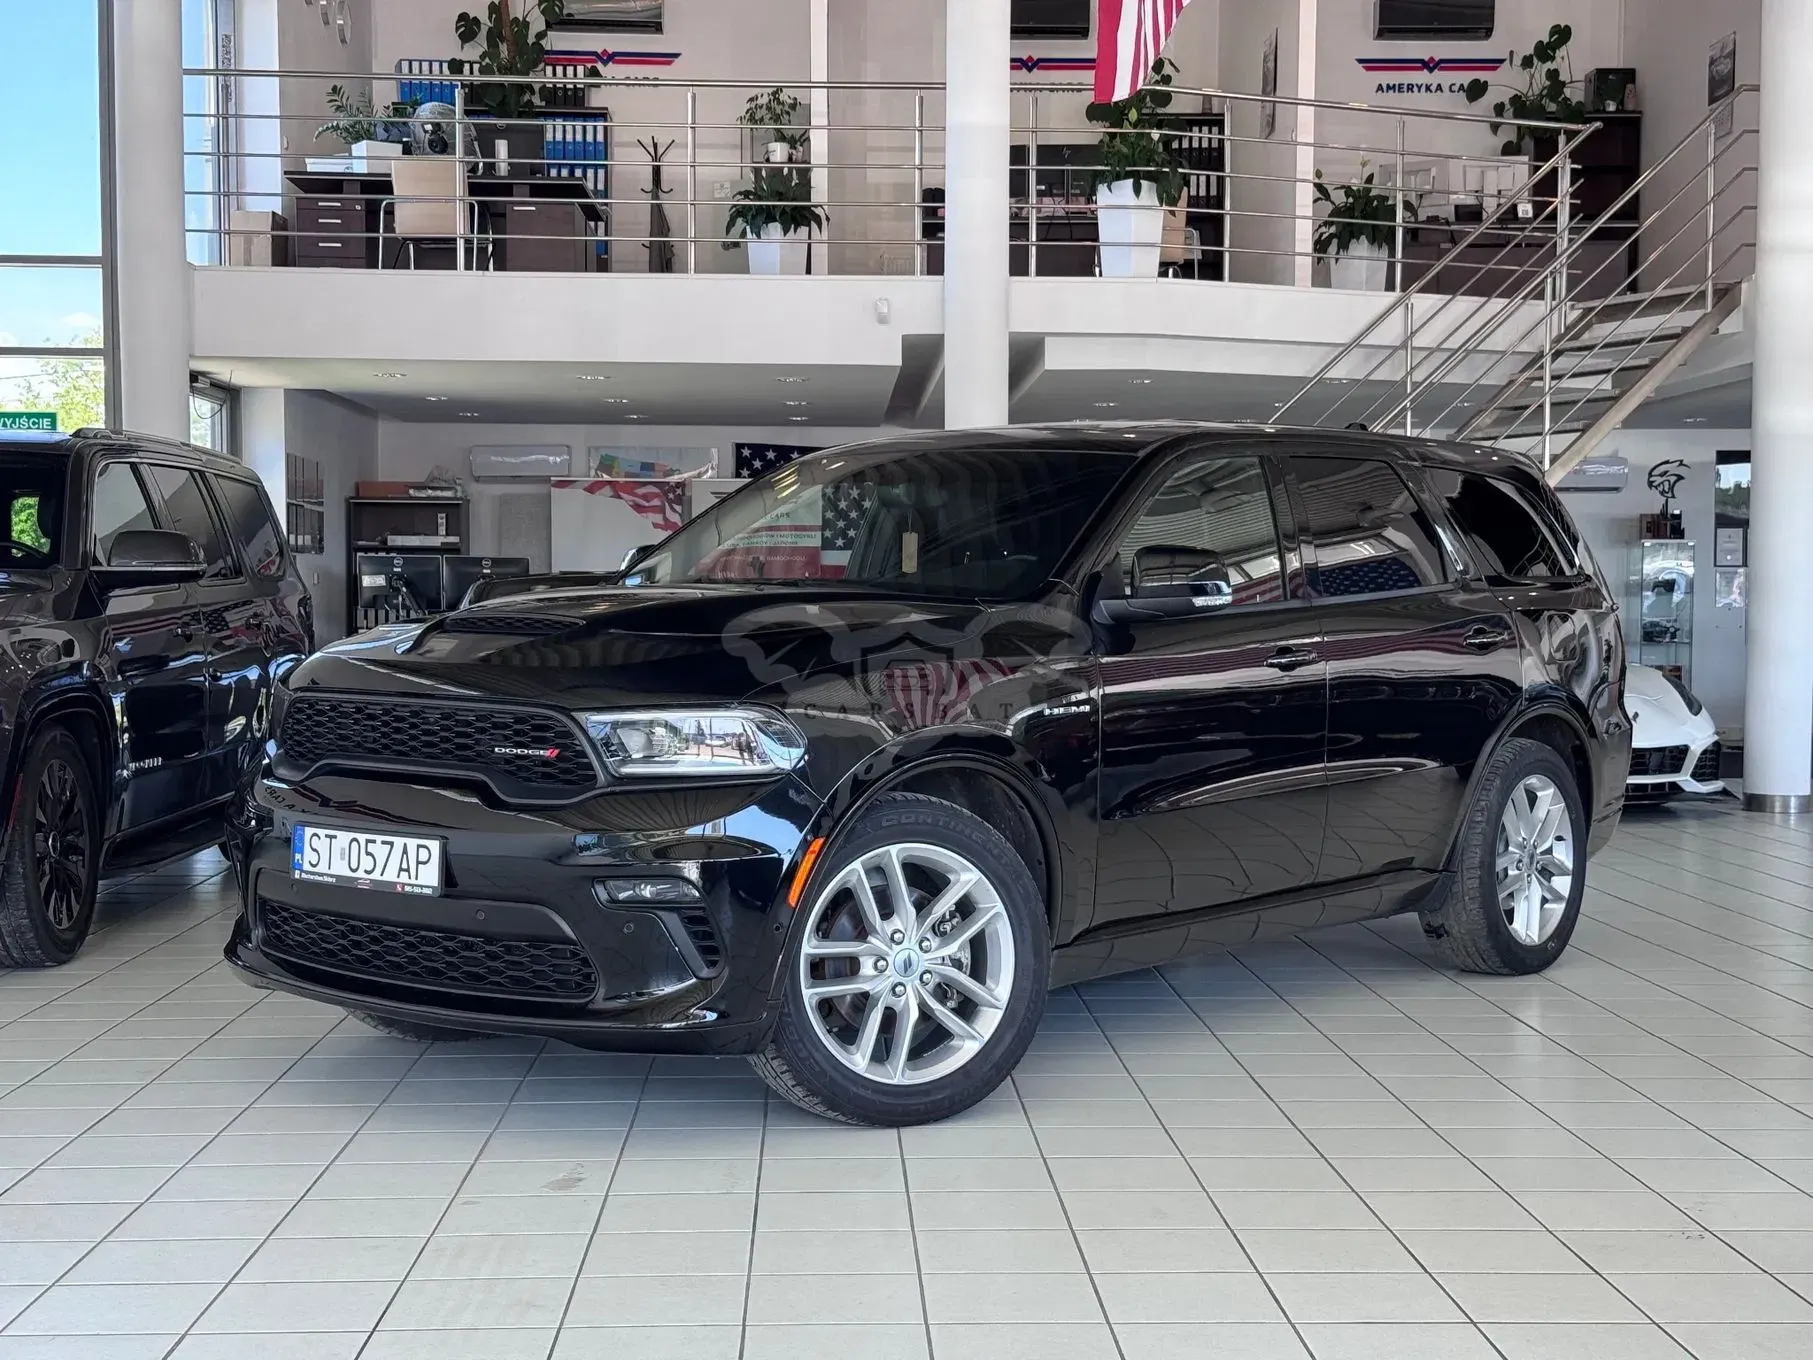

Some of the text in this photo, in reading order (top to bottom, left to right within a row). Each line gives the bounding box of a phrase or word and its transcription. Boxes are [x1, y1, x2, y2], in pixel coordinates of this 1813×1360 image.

[1375, 83, 1444, 94] AMERYKA
[1043, 705, 1090, 716] HEMI
[494, 747, 548, 756] DODGE
[309, 832, 431, 881] ST 057AP
